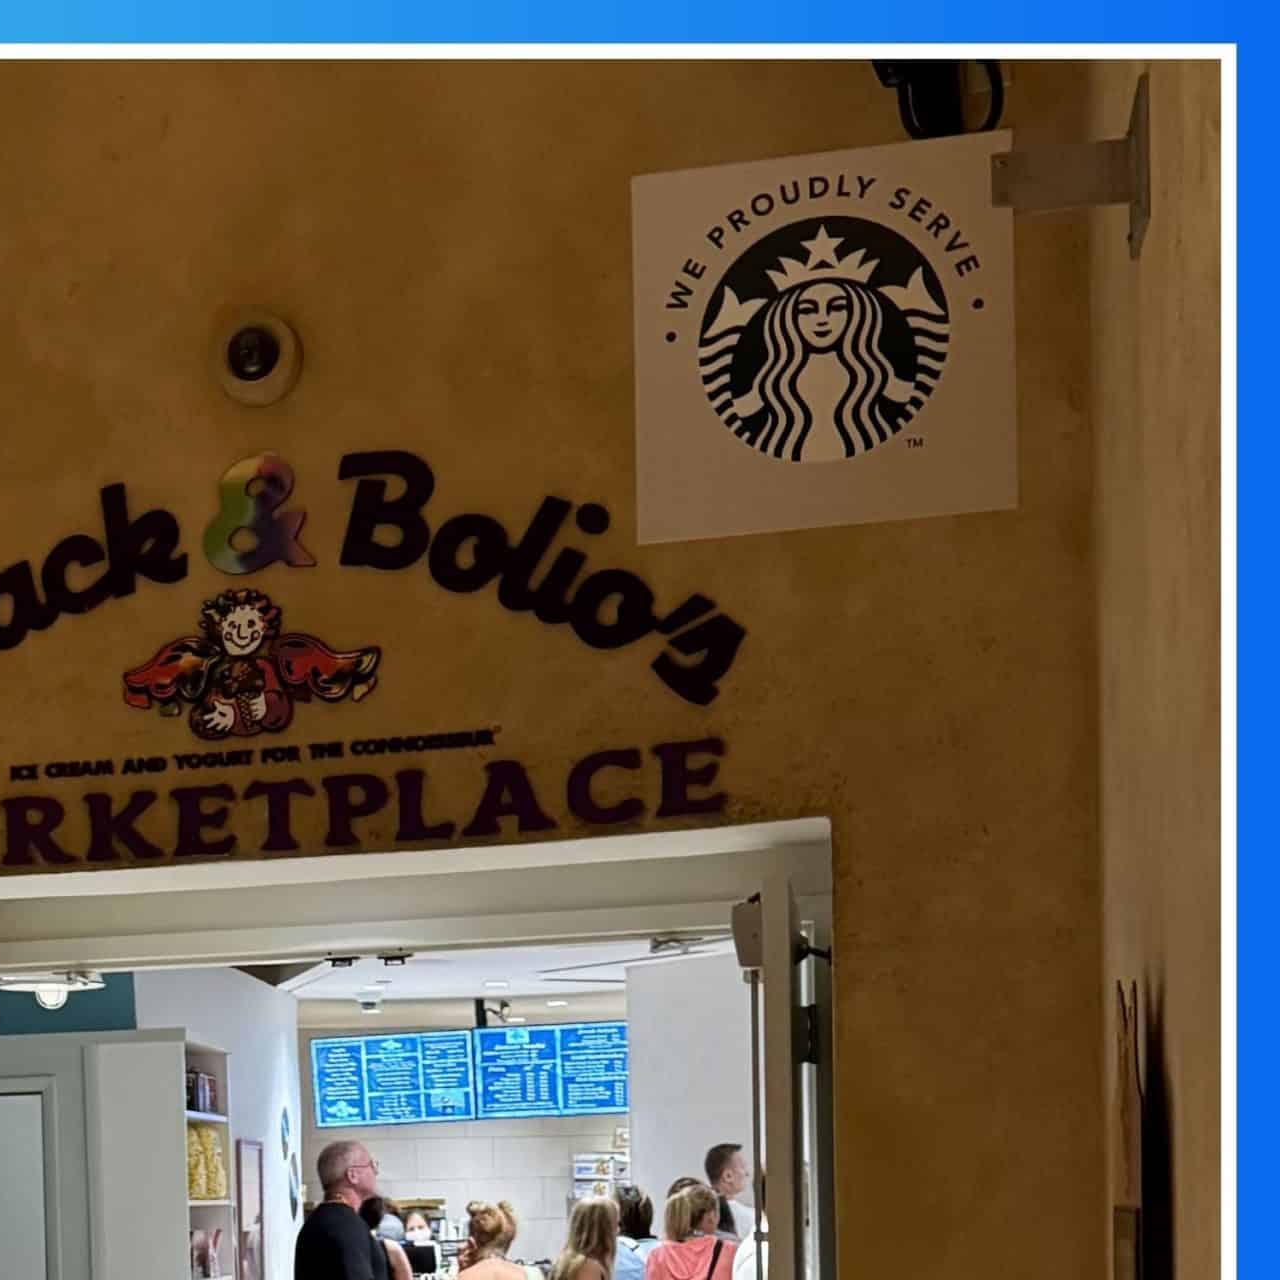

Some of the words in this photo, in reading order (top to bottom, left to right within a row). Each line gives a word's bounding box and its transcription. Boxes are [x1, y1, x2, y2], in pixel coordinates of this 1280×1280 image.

[666, 258, 707, 309] WE
[707, 174, 876, 248] PROUDLY
[889, 187, 980, 277] SERVE
[202, 450, 316, 575] &
[337, 450, 747, 706] Bolio's
[10, 763, 38, 781] ICE
[45, 759, 114, 778] CREAM
[122, 757, 167, 775] AND
[175, 750, 254, 770] YOGURT
[261, 746, 300, 763] FOR
[309, 742, 344, 760] THE
